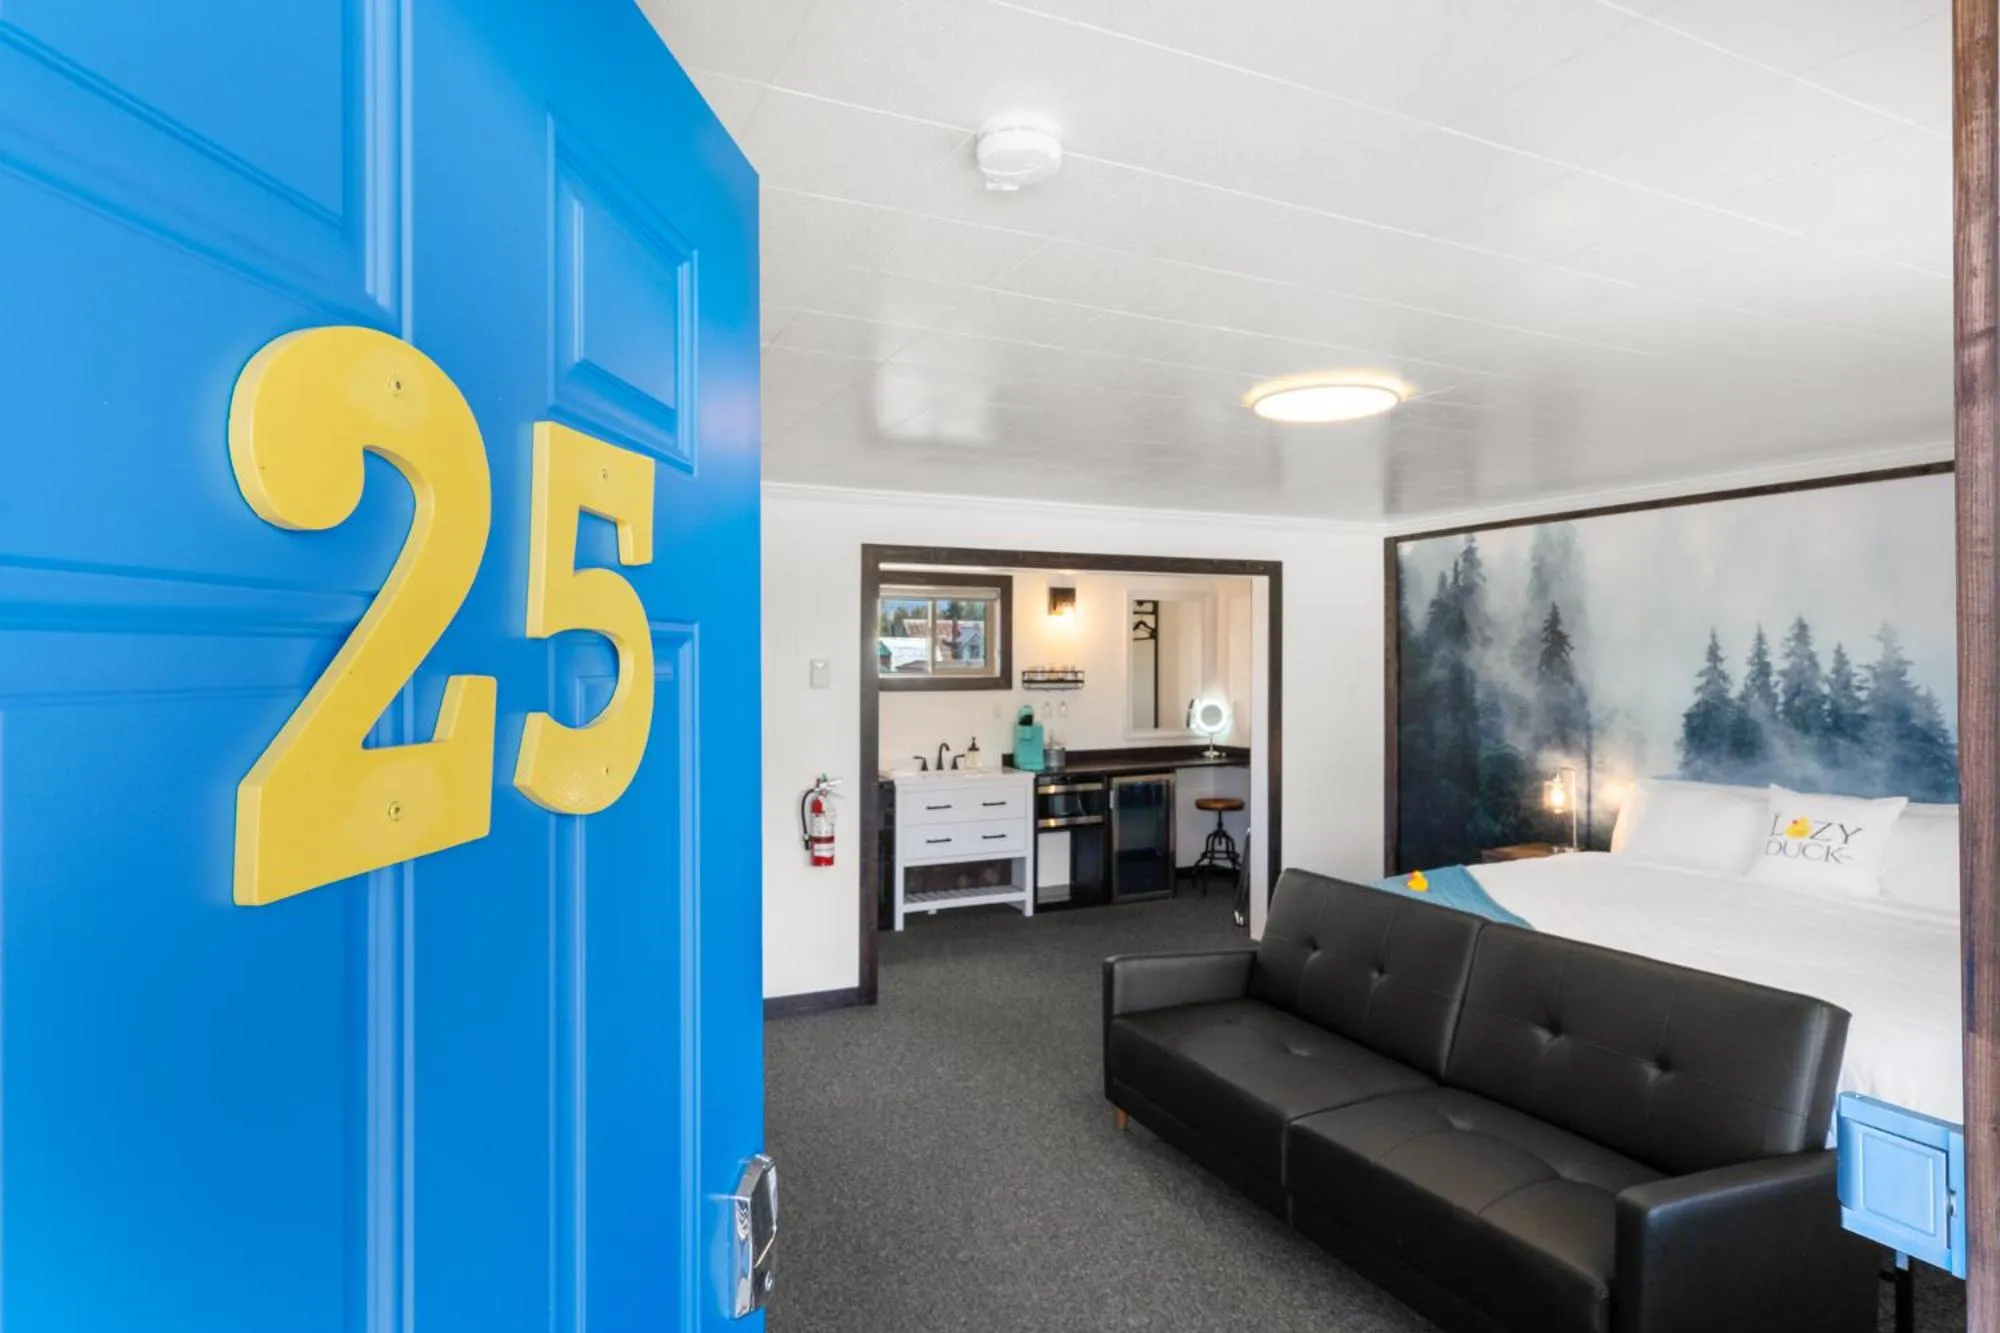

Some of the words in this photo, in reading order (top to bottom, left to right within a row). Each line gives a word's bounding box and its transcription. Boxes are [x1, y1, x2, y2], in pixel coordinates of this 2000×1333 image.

[228, 325, 655, 906] 25
[1770, 812, 1863, 844] LZY
[1764, 839, 1848, 864] DUCK
